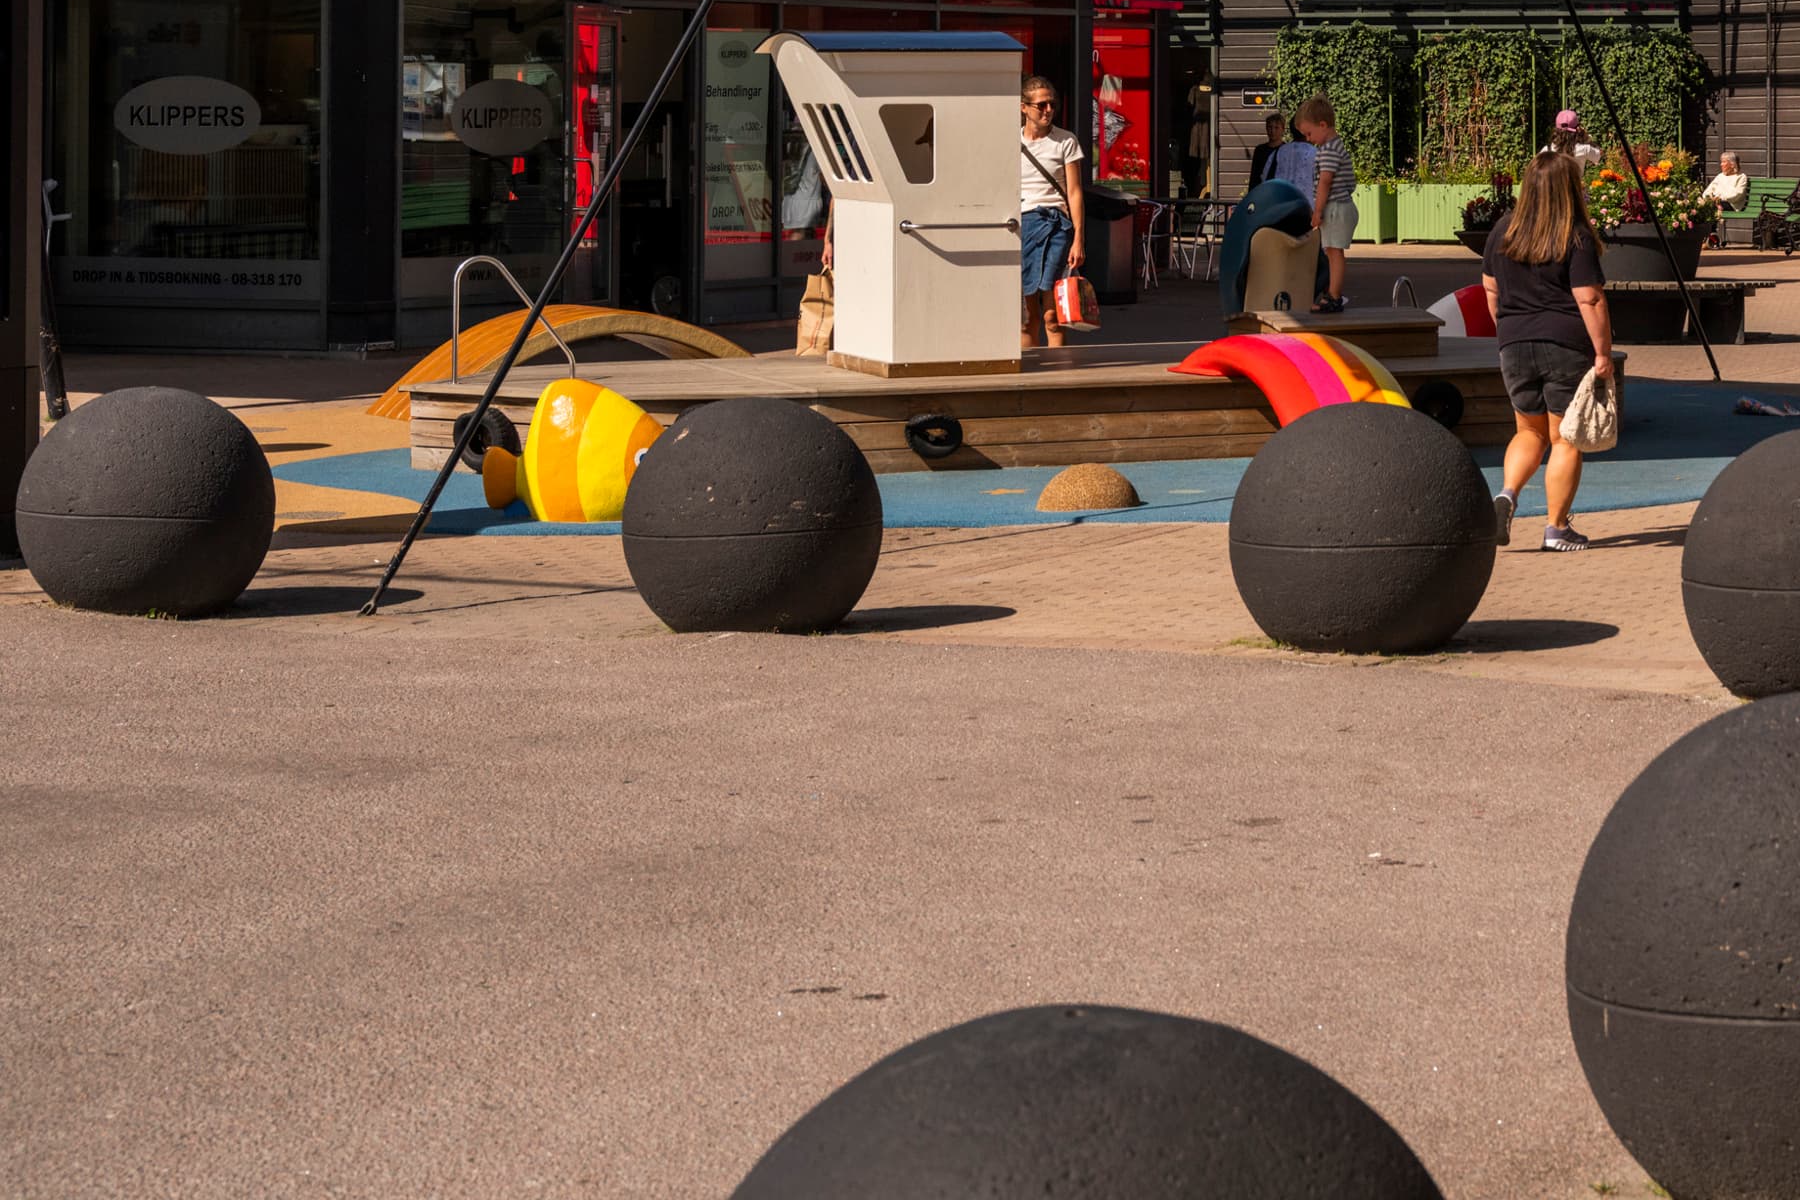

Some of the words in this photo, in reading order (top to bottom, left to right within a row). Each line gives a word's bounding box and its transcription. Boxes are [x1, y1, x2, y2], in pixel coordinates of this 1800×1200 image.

[706, 85, 763, 100] Behandlingar
[129, 105, 245, 128] KLIPPERS
[461, 107, 543, 129] KLIPPERS
[712, 205, 736, 218] DROP
[72, 270, 106, 283] DROP
[110, 271, 122, 283] IN
[126, 271, 136, 283] &
[139, 271, 222, 286] TIDSBOKNING
[232, 273, 275, 286] 08-318
[279, 274, 302, 287] 170
